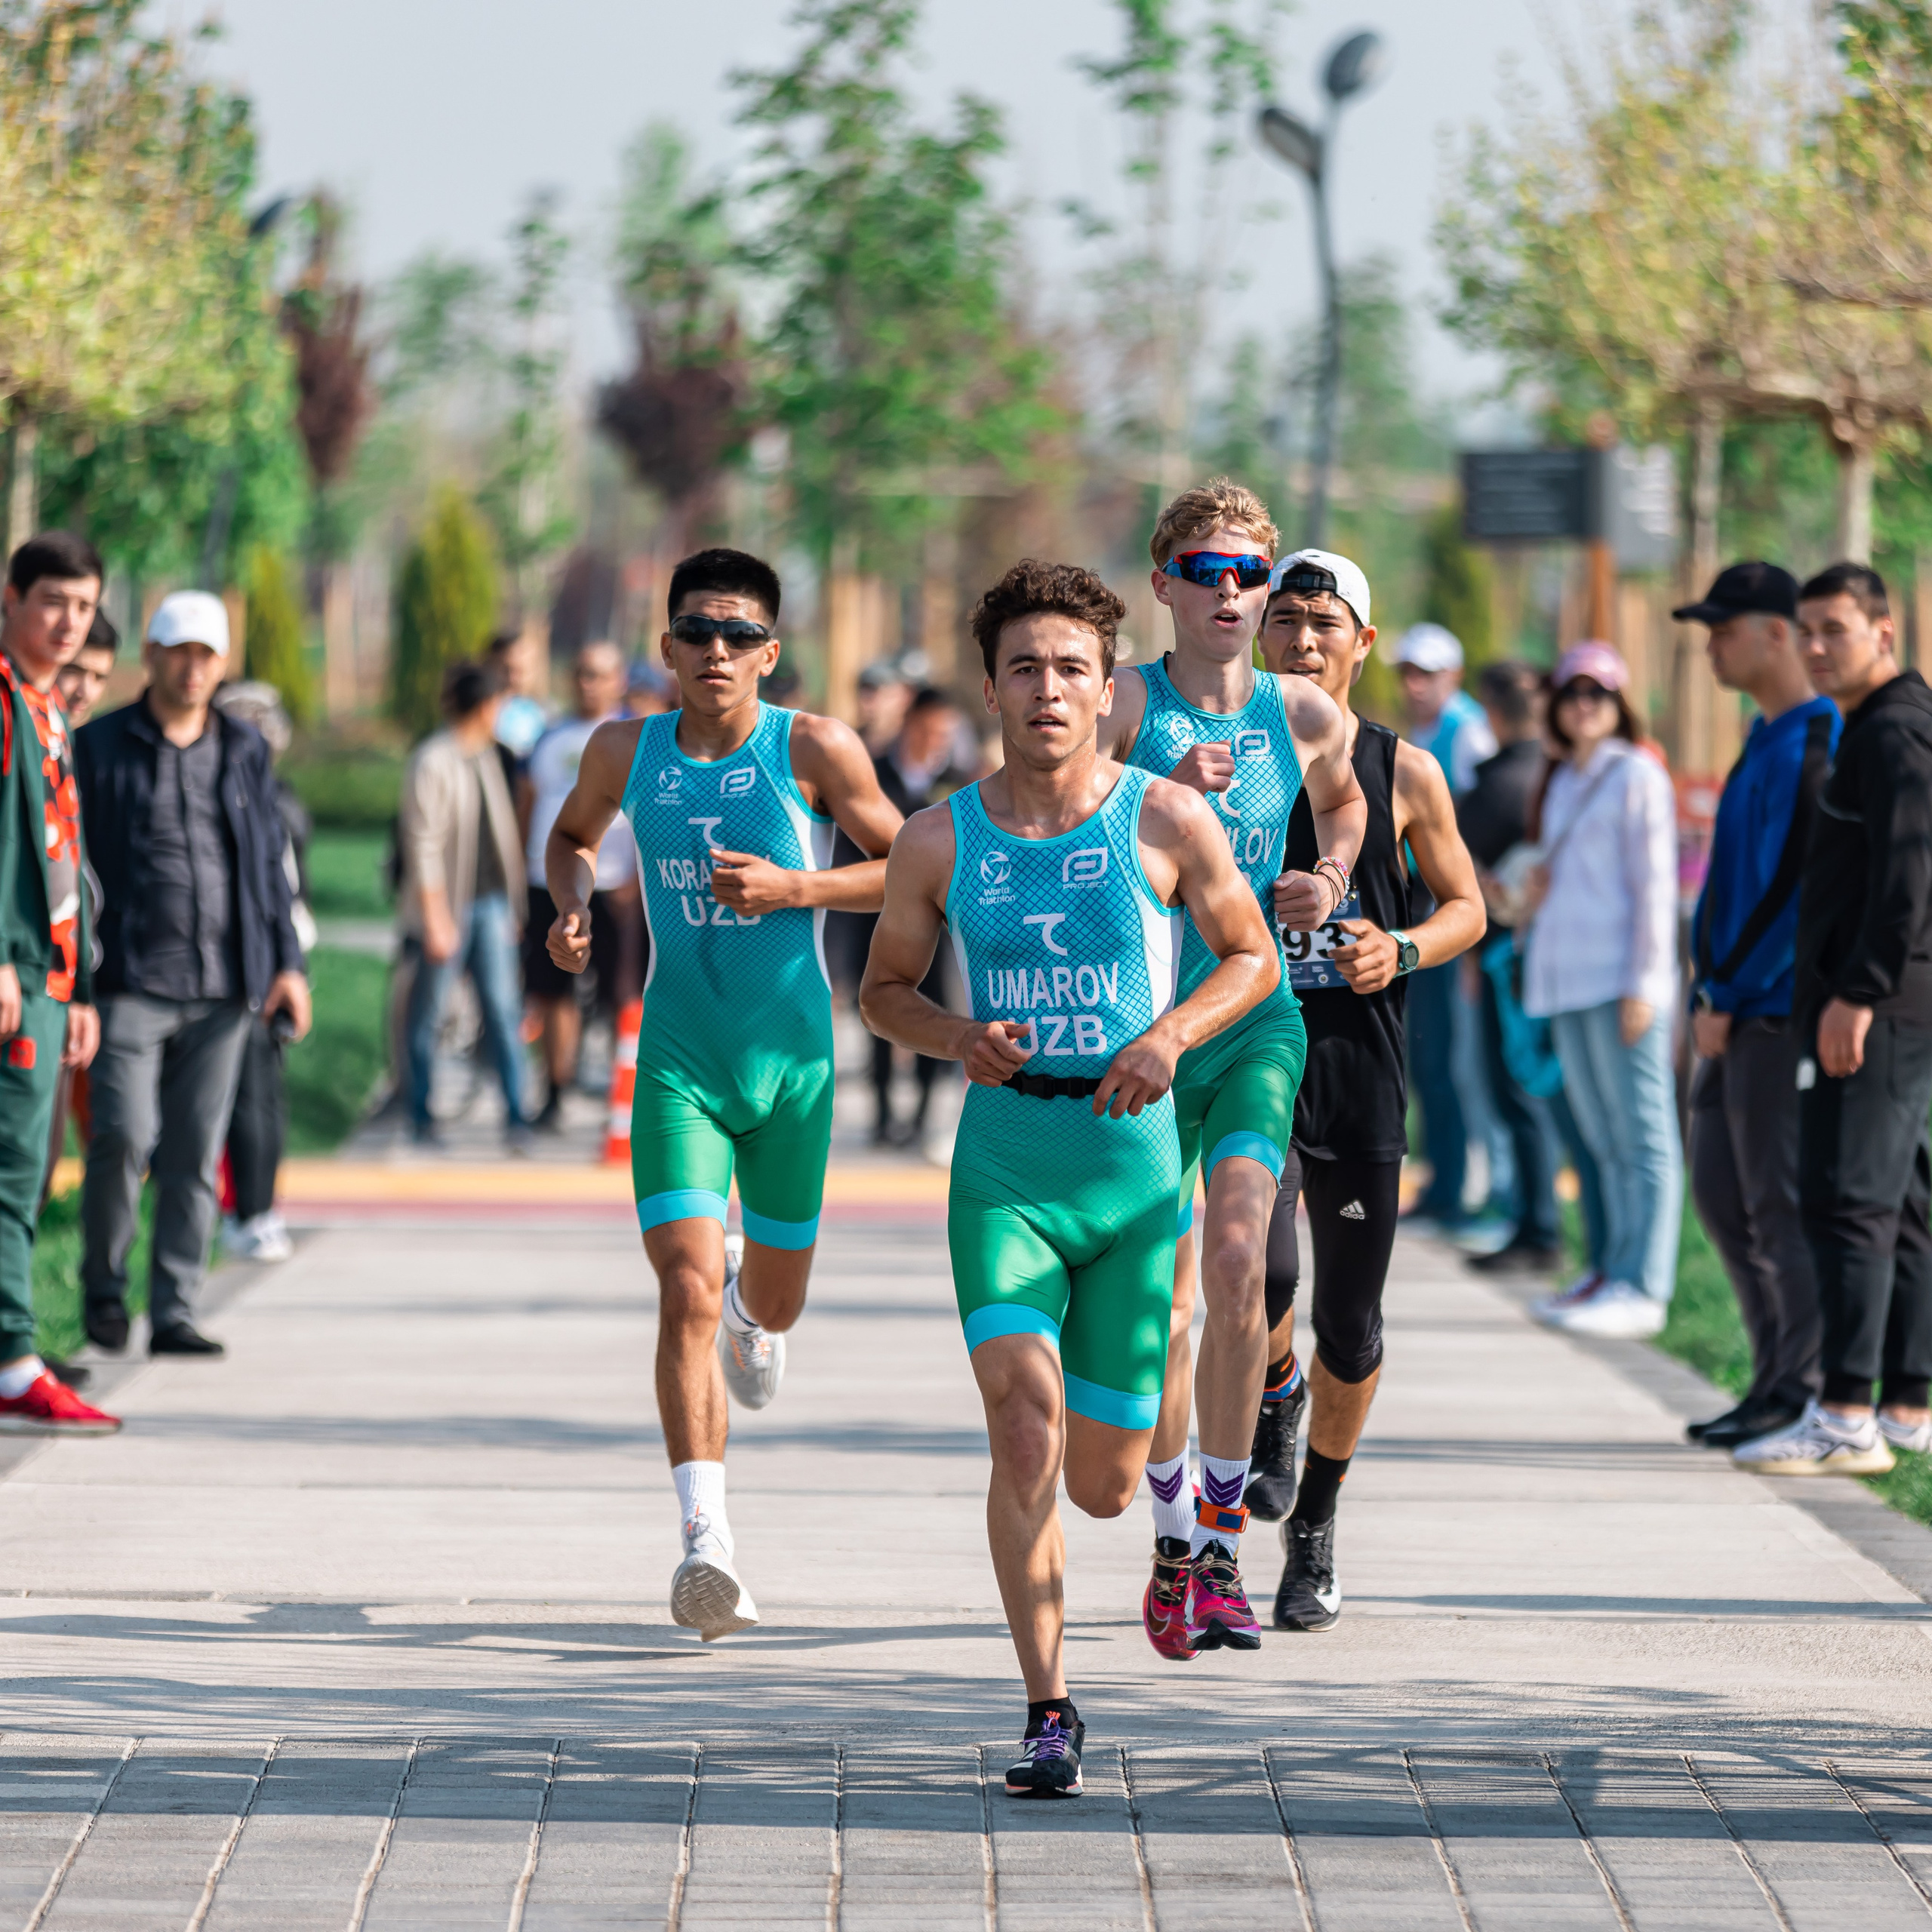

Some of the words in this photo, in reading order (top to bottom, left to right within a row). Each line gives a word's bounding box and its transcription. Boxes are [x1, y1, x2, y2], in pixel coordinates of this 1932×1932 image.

[1063, 881, 1109, 890] PROJECT
[983, 886, 1009, 897] World
[977, 894, 1016, 906] Triathlon
[987, 962, 1118, 1009] UMAROV
